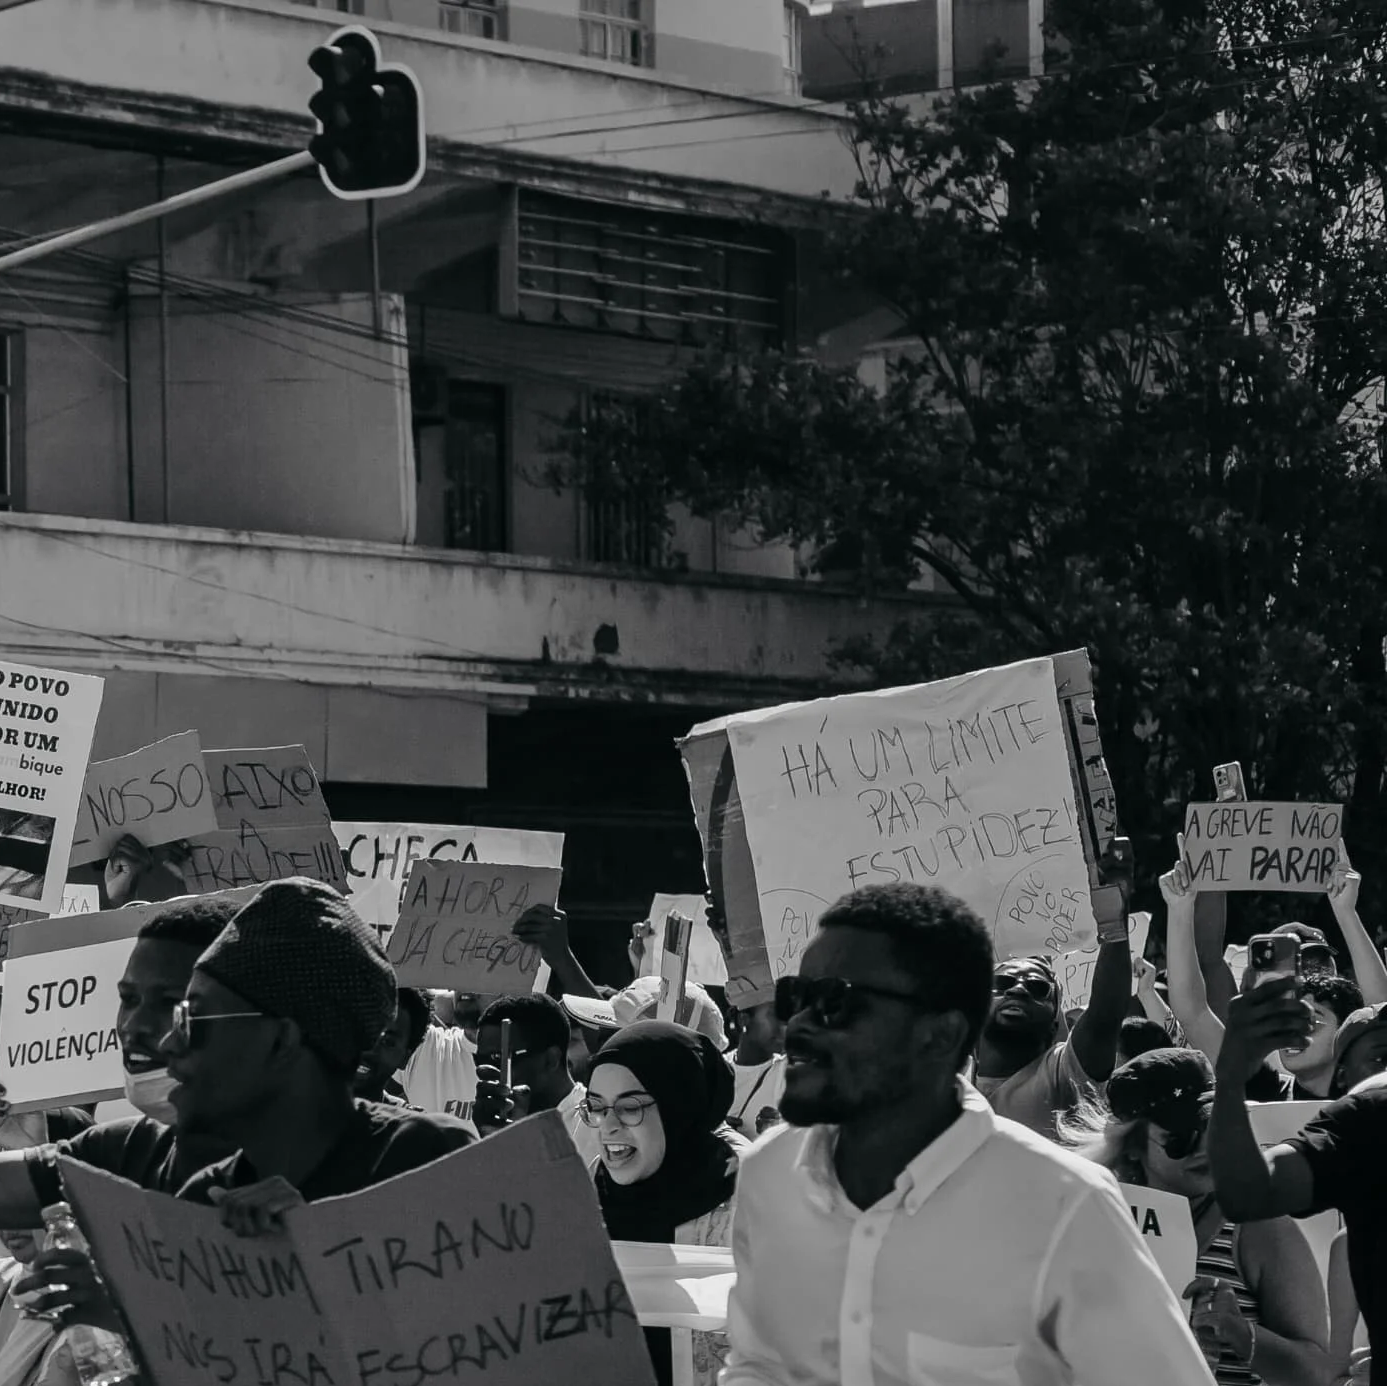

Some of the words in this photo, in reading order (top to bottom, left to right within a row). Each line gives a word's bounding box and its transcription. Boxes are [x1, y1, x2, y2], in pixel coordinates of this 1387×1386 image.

[8, 672, 71, 697] POVO
[23, 731, 60, 753] UM
[780, 712, 838, 799] HÁ
[848, 726, 916, 783] UM
[86, 763, 204, 836] NOSSO
[221, 763, 315, 811] AIXO
[856, 775, 970, 838] PARA
[1185, 810, 1200, 839] A
[1207, 807, 1274, 840] GREVE
[1291, 805, 1339, 841] NÃO
[1185, 848, 1232, 882] VAI
[1249, 846, 1336, 885] PARAR
[437, 876, 530, 917] HORA
[24, 975, 97, 1015] STOP
[121, 1221, 321, 1315] NENHUM
[322, 1201, 537, 1296] TIRANO
